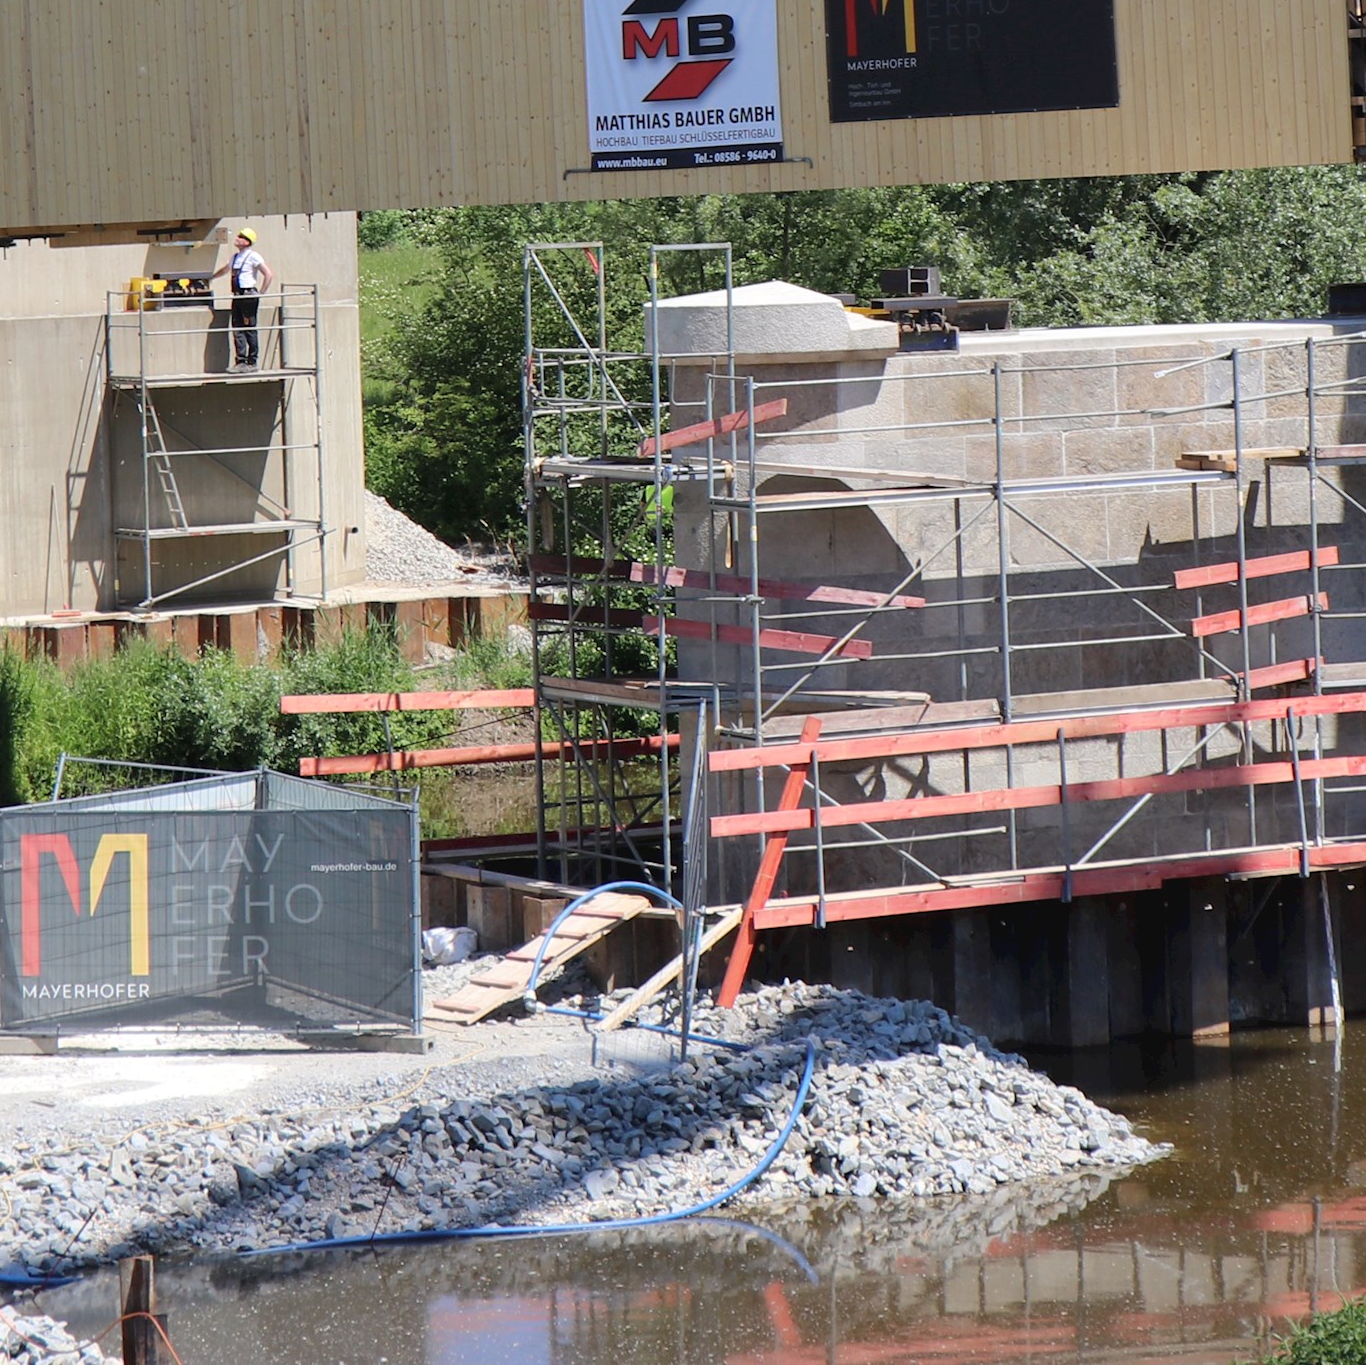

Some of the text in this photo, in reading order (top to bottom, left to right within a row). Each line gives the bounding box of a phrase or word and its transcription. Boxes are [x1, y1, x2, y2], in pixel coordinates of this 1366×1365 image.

[621, 13, 736, 60] MB
[847, 57, 917, 71] MAYERHOFER
[596, 106, 775, 132] MATTHIAS BAUER GMBH
[596, 128, 776, 147] HOCHBAU TIEFBAU SCHLÜSSELFERTIGBAU
[597, 157, 667, 168] www.mbbau.eu
[694, 152, 713, 164] Tel.:
[714, 151, 740, 163] 08586
[747, 149, 776, 161] 9640-0
[171, 833, 285, 873] MAY
[310, 862, 397, 874] mayerhofer-bau.de
[172, 883, 324, 925] ERHO
[172, 936, 271, 976] FER
[22, 983, 151, 1000] MAYERHOFER
